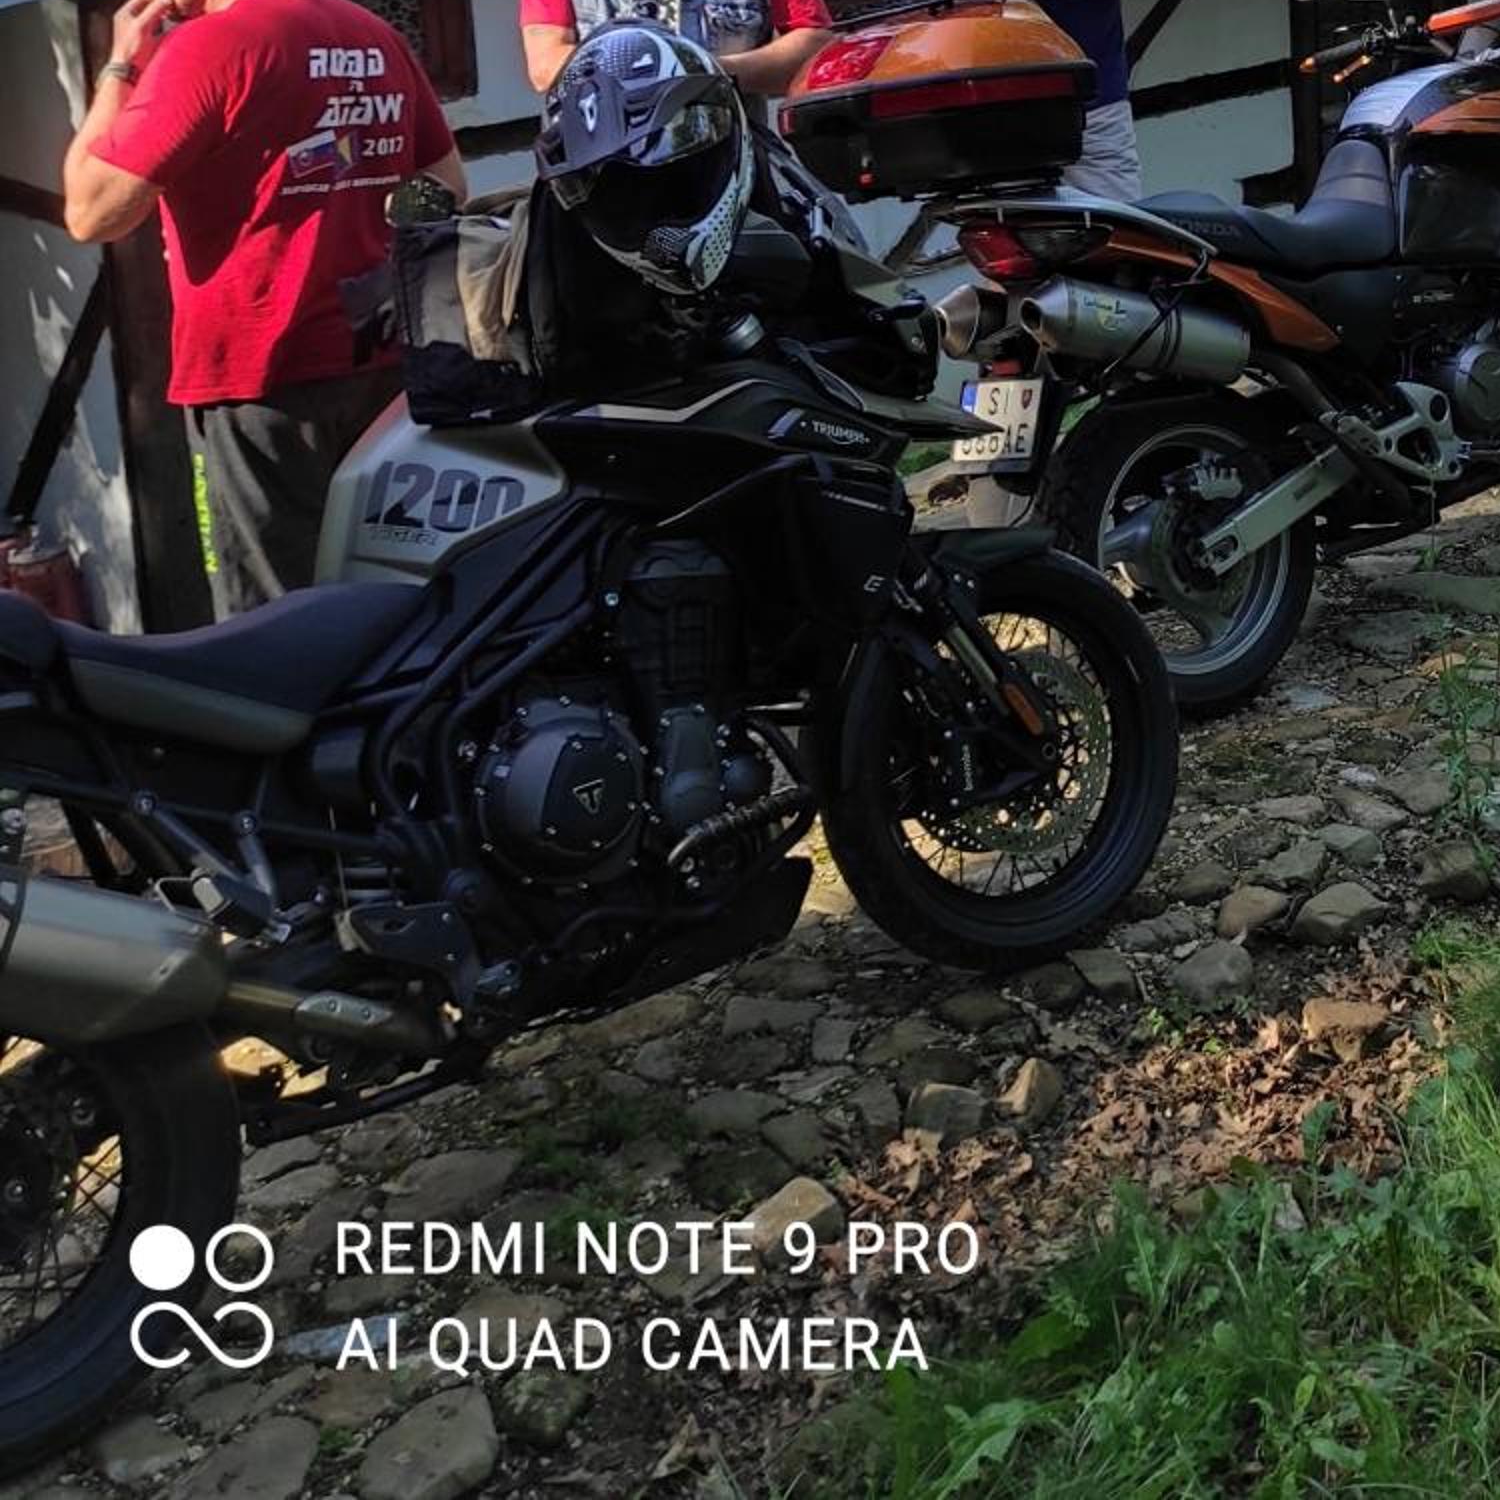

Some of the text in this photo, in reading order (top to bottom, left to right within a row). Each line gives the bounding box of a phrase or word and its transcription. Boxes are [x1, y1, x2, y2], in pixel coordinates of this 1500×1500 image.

[309, 48, 385, 78] ROAD
[362, 136, 404, 157] 2017
[988, 387, 1010, 415] SI
[811, 419, 865, 445] TRIUMPH
[364, 460, 526, 533] 1200
